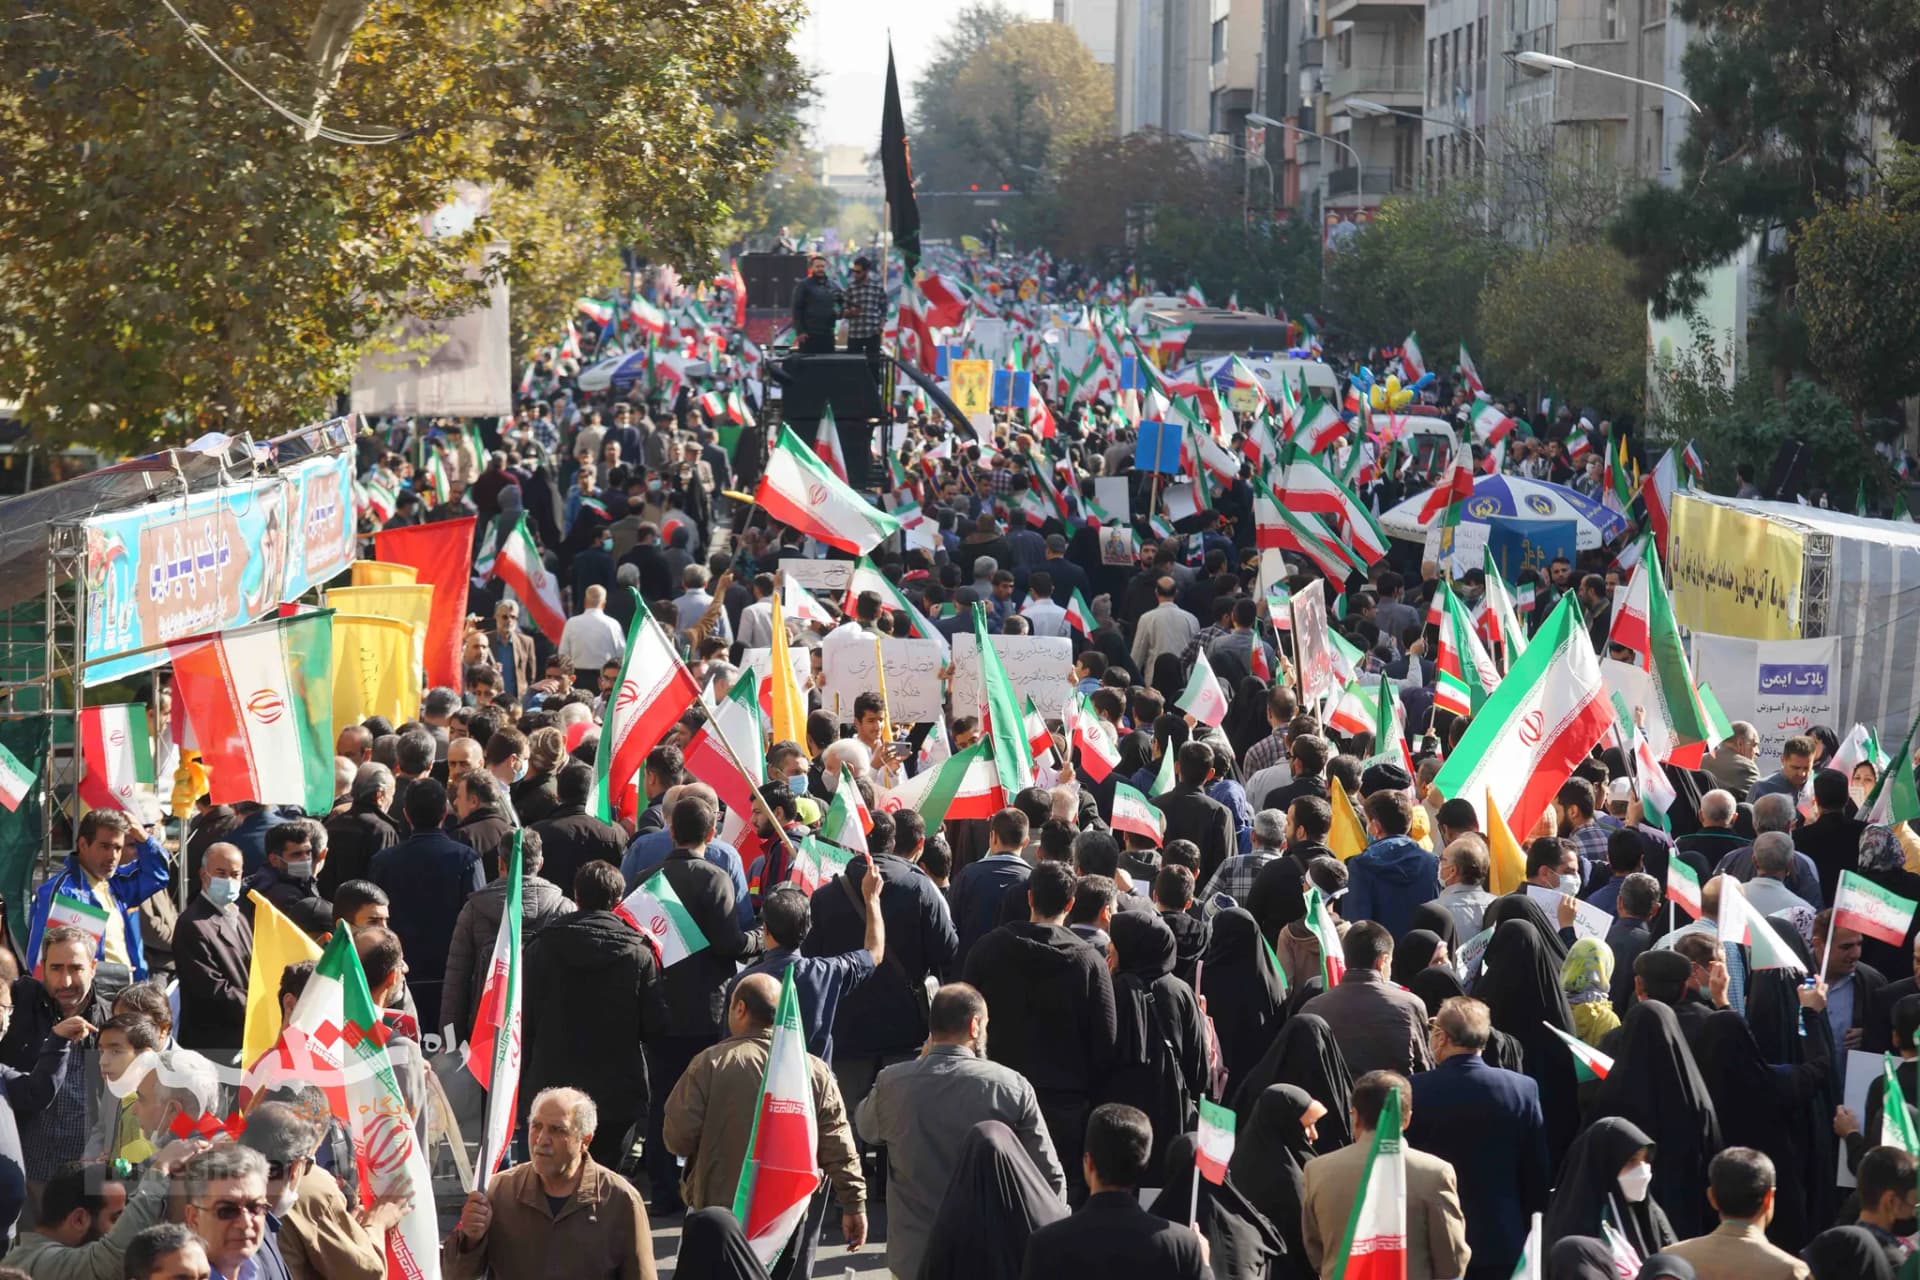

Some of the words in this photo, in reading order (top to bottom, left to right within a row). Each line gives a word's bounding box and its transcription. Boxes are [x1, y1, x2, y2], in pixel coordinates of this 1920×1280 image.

[1761, 671, 1792, 689] ایمن
[1795, 671, 1825, 689] پلاک
[1756, 702, 1785, 713] آموزش
[1791, 703, 1810, 714] بازدید
[1811, 704, 1830, 714] طرح
[1777, 716, 1809, 730] رایگان
